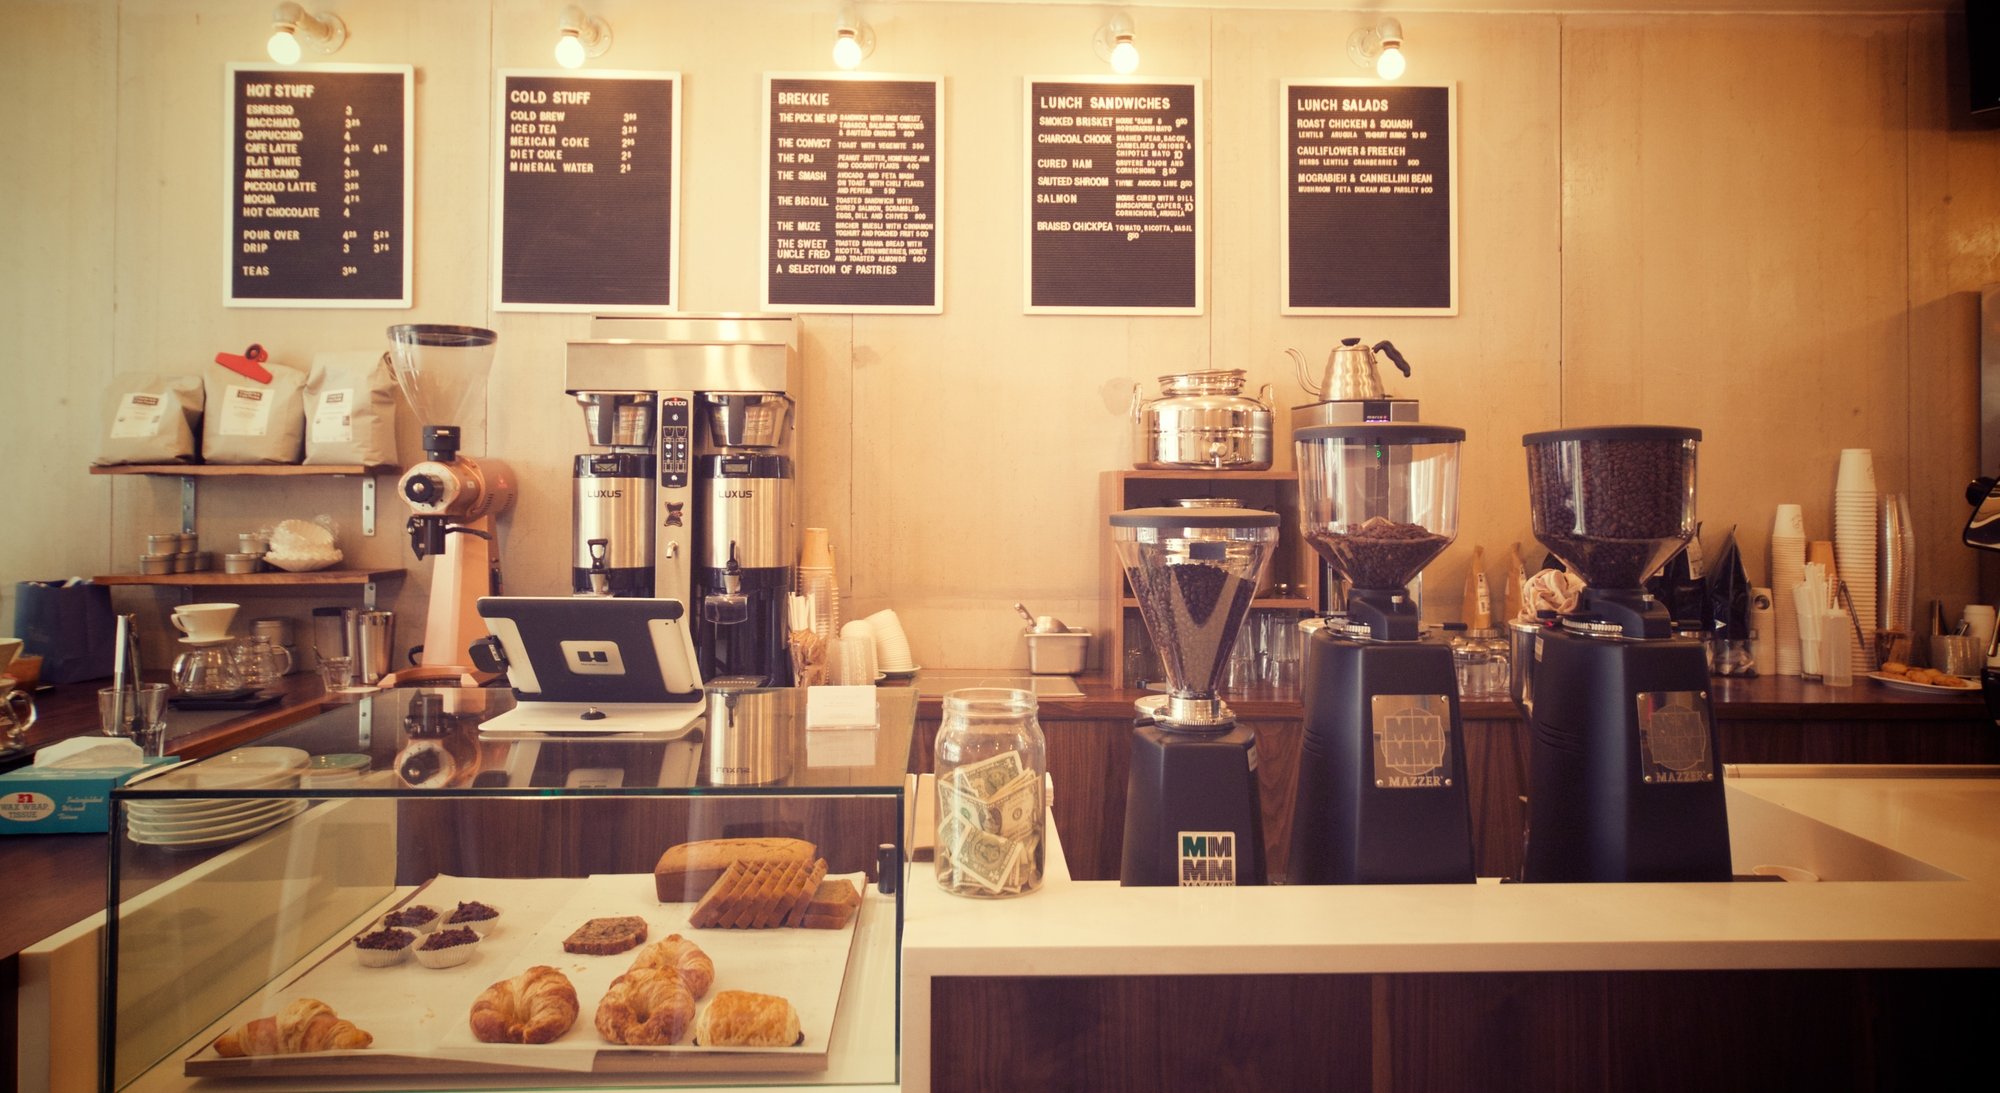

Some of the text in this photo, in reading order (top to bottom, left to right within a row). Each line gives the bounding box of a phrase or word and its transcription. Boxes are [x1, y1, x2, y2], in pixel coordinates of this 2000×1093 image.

[247, 84, 314, 98] HOT STUFF
[511, 90, 590, 104] COLD STUFF
[778, 92, 829, 106] BREKKIE
[1041, 97, 1170, 109] LUNCH SANDWICHES
[1297, 99, 1388, 111] LUNCH SALADS
[247, 105, 352, 115] ESPRESSO 3
[510, 111, 565, 121] COLD BREW
[779, 113, 838, 123] THE PICK ME UP
[246, 118, 300, 128] MACCHIATO
[1039, 117, 1113, 127] SMOKED BRISKET
[1297, 119, 1413, 129] ROAST CHICKEN & SQUASH
[511, 124, 556, 134] ICED TEA
[246, 131, 351, 141] CAPPUCCINO 4
[1038, 134, 1112, 144] CHARCOAL CHOOK
[510, 137, 589, 147] MEXICAN COKE
[778, 139, 831, 148] THE CONVICT
[245, 144, 297, 154] CAFE LATTE
[1297, 146, 1405, 156] CAULIFLOWER & FREEKEH
[510, 150, 562, 159] DIET COKE
[778, 153, 814, 163] THE PBJ
[246, 156, 351, 167] FLAT WHITE 4
[1038, 159, 1092, 168] CURED HAM
[510, 162, 593, 173] MINERAL WATER
[245, 169, 299, 179] AMERICANO
[777, 171, 826, 181] THE SMASH
[1298, 173, 1432, 183] MOGRABIEH & CANNELLINI BEAN
[1038, 177, 1109, 186] SAUTEED SHROOM
[244, 182, 316, 192] PICCOLO LATTE
[244, 194, 275, 204] MOCHA
[777, 196, 829, 206] THE BIG DILL
[1037, 194, 1077, 203] SALMON
[243, 208, 350, 218] HOT CHOCOLATE 4
[777, 221, 820, 231] THE MUZE
[1037, 222, 1113, 231] BRAISED CHICKPEA
[243, 231, 299, 240] POUR OVER
[244, 244, 349, 253] DRIP 3
[777, 239, 827, 249] THE SWEET
[777, 250, 830, 259] UNCLE FRED
[243, 266, 269, 276] TEAS
[776, 264, 897, 275] A SELECTION OF PASTRIES
[1389, 776, 1441, 786] MAZZER
[1656, 771, 1704, 782] MAZZER
